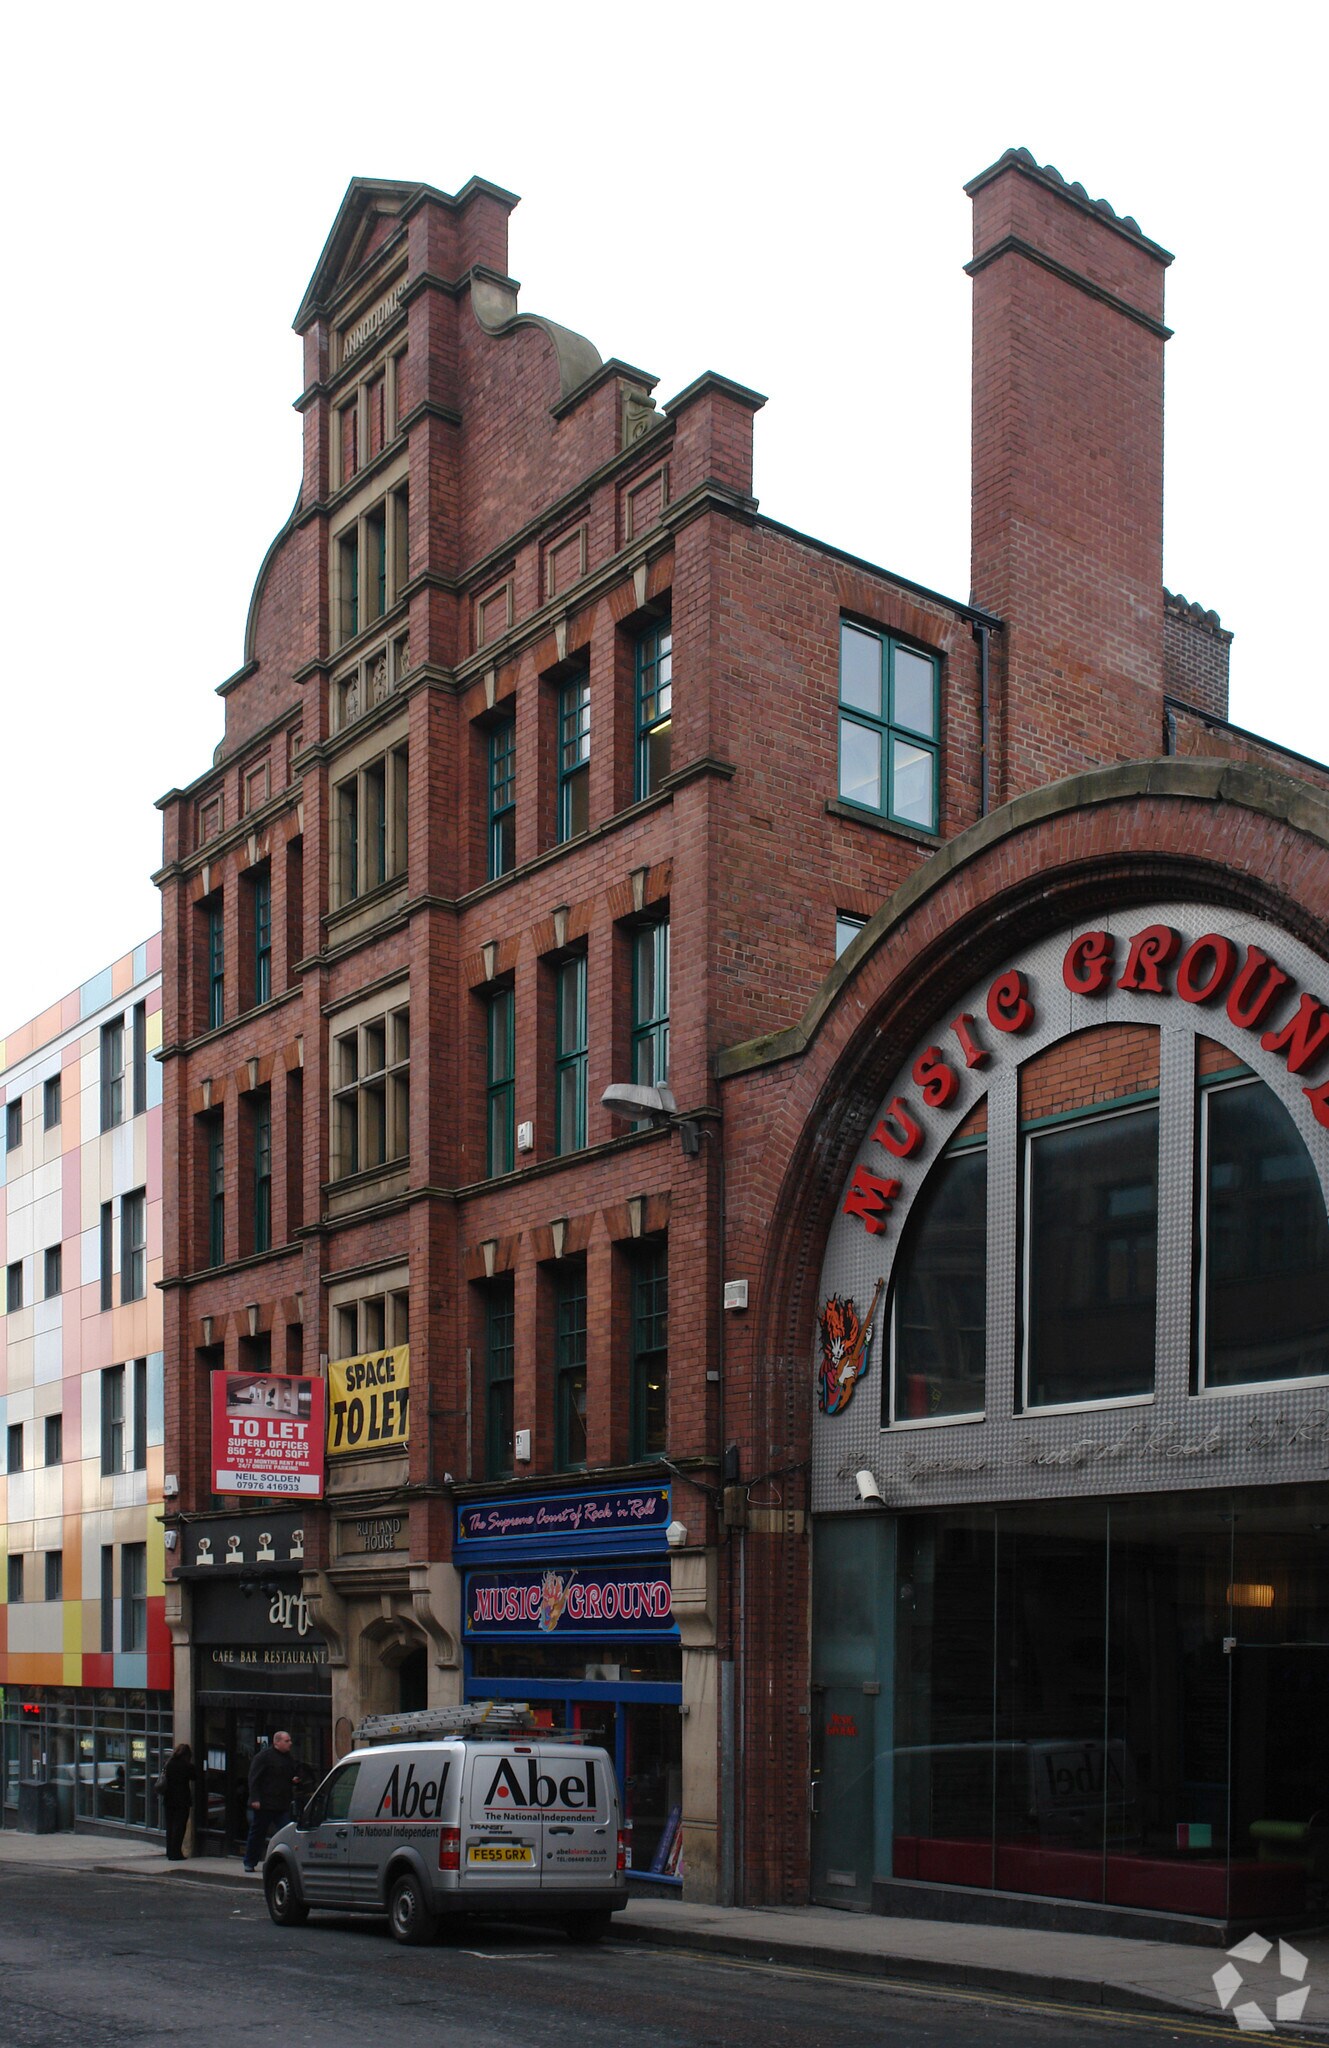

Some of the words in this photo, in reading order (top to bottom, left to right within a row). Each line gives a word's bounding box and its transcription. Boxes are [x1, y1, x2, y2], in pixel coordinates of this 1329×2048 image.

[843, 968, 1036, 1236] MUSIC
[345, 1355, 395, 1392] SPACE
[333, 1397, 364, 1447] TO
[367, 1387, 410, 1442] LET
[229, 1419, 259, 1437] TO
[267, 1421, 309, 1439] LET
[228, 1438, 266, 1448] SUPERB
[269, 1440, 309, 1450] OFFICES
[227, 1447, 246, 1456] 850
[254, 1448, 282, 1458] 2,400
[285, 1450, 310, 1459] SQFT
[235, 1472, 258, 1481] NEIL
[260, 1474, 301, 1483] SOLDEN
[236, 1481, 264, 1490] 07976
[266, 1483, 299, 1491] 416933
[469, 1512, 487, 1531] The
[487, 1511, 534, 1533] Supreme
[536, 1507, 569, 1524] Court
[569, 1504, 582, 1529] of
[584, 1502, 613, 1523] Rock
[356, 1518, 401, 1536] RUTLAND
[364, 1534, 394, 1550] HOUSE
[473, 1585, 543, 1622] MUSIC
[567, 1580, 672, 1619] GROUND
[212, 1650, 234, 1663] CAFE
[240, 1650, 257, 1663] BAR
[264, 1650, 327, 1664] RESTAURANT
[375, 1762, 451, 1819] Abel
[484, 1758, 597, 1809] Abel
[485, 1812, 502, 1821] The
[504, 1813, 541, 1822] National
[541, 1813, 595, 1823] Independent
[353, 1826, 364, 1837] The
[365, 1826, 393, 1838] National
[394, 1826, 439, 1840] Independent
[474, 1849, 503, 1860] FE55
[505, 1850, 526, 1860] GRX
